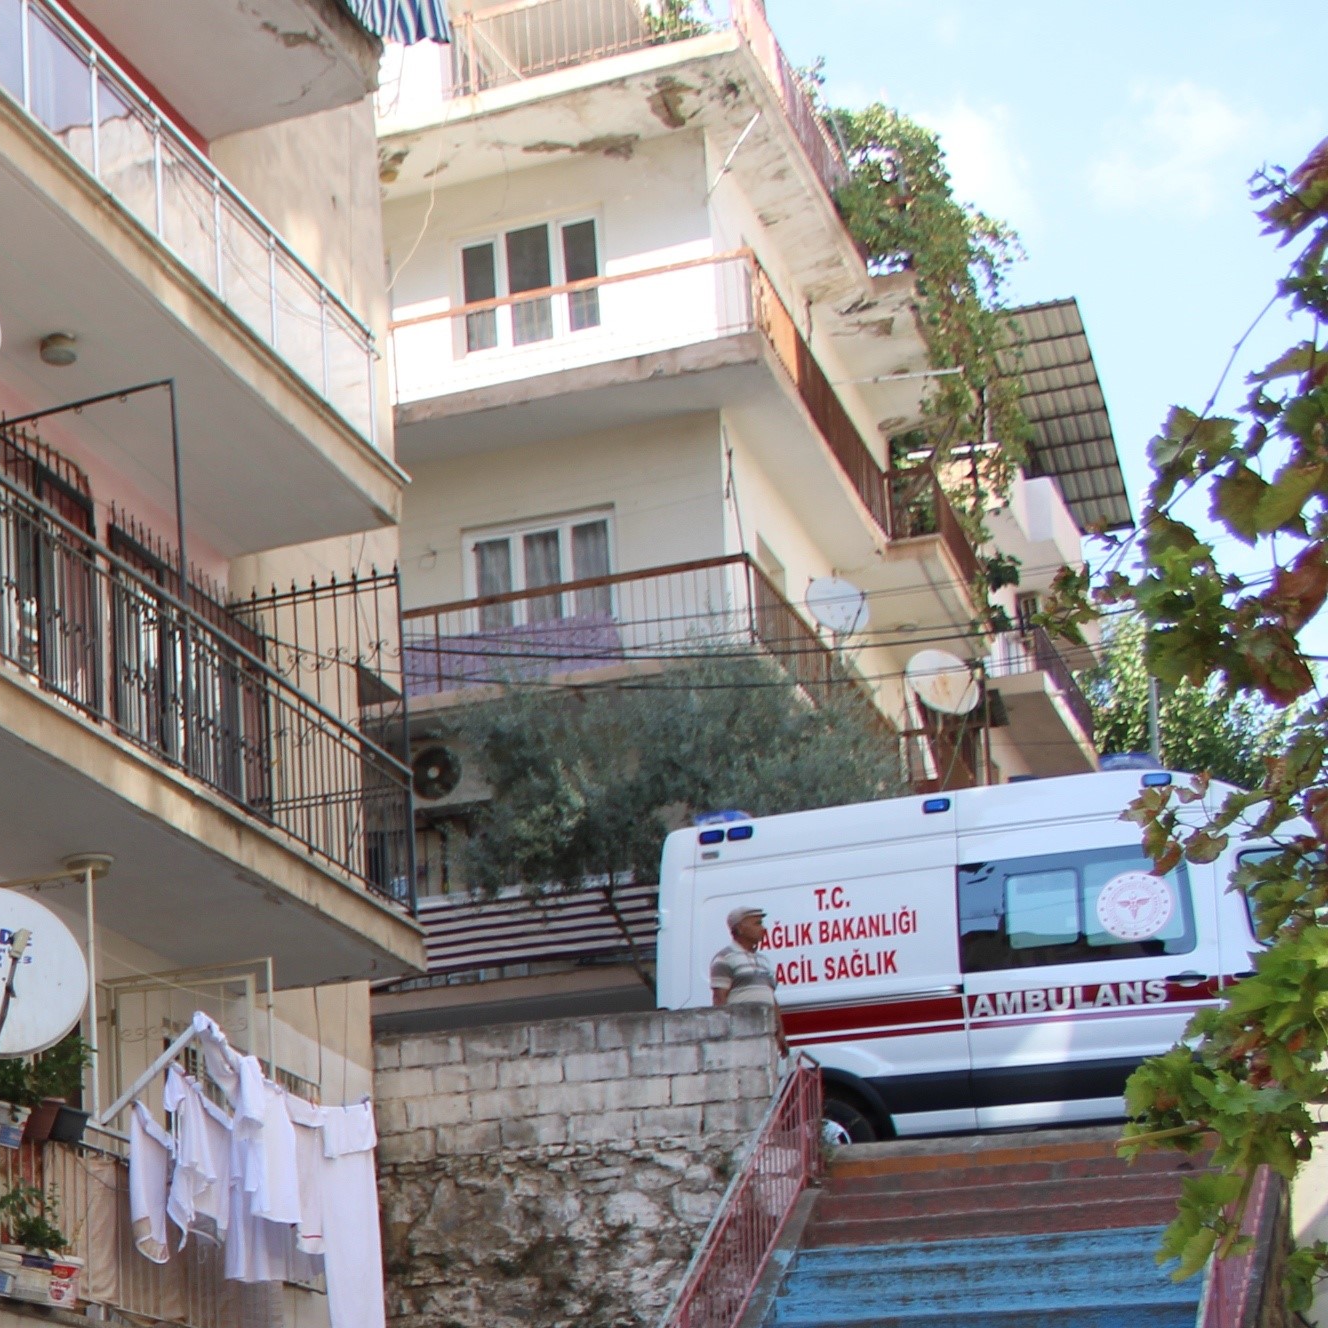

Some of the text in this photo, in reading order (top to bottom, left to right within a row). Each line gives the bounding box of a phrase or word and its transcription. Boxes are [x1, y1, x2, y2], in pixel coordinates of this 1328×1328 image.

[814, 886, 850, 911] T.C.
[758, 905, 917, 951] AĞLIK BAKANLIĞI
[775, 948, 897, 986] ACİL SAĞLIK
[972, 979, 1168, 1018] AMBULANS
